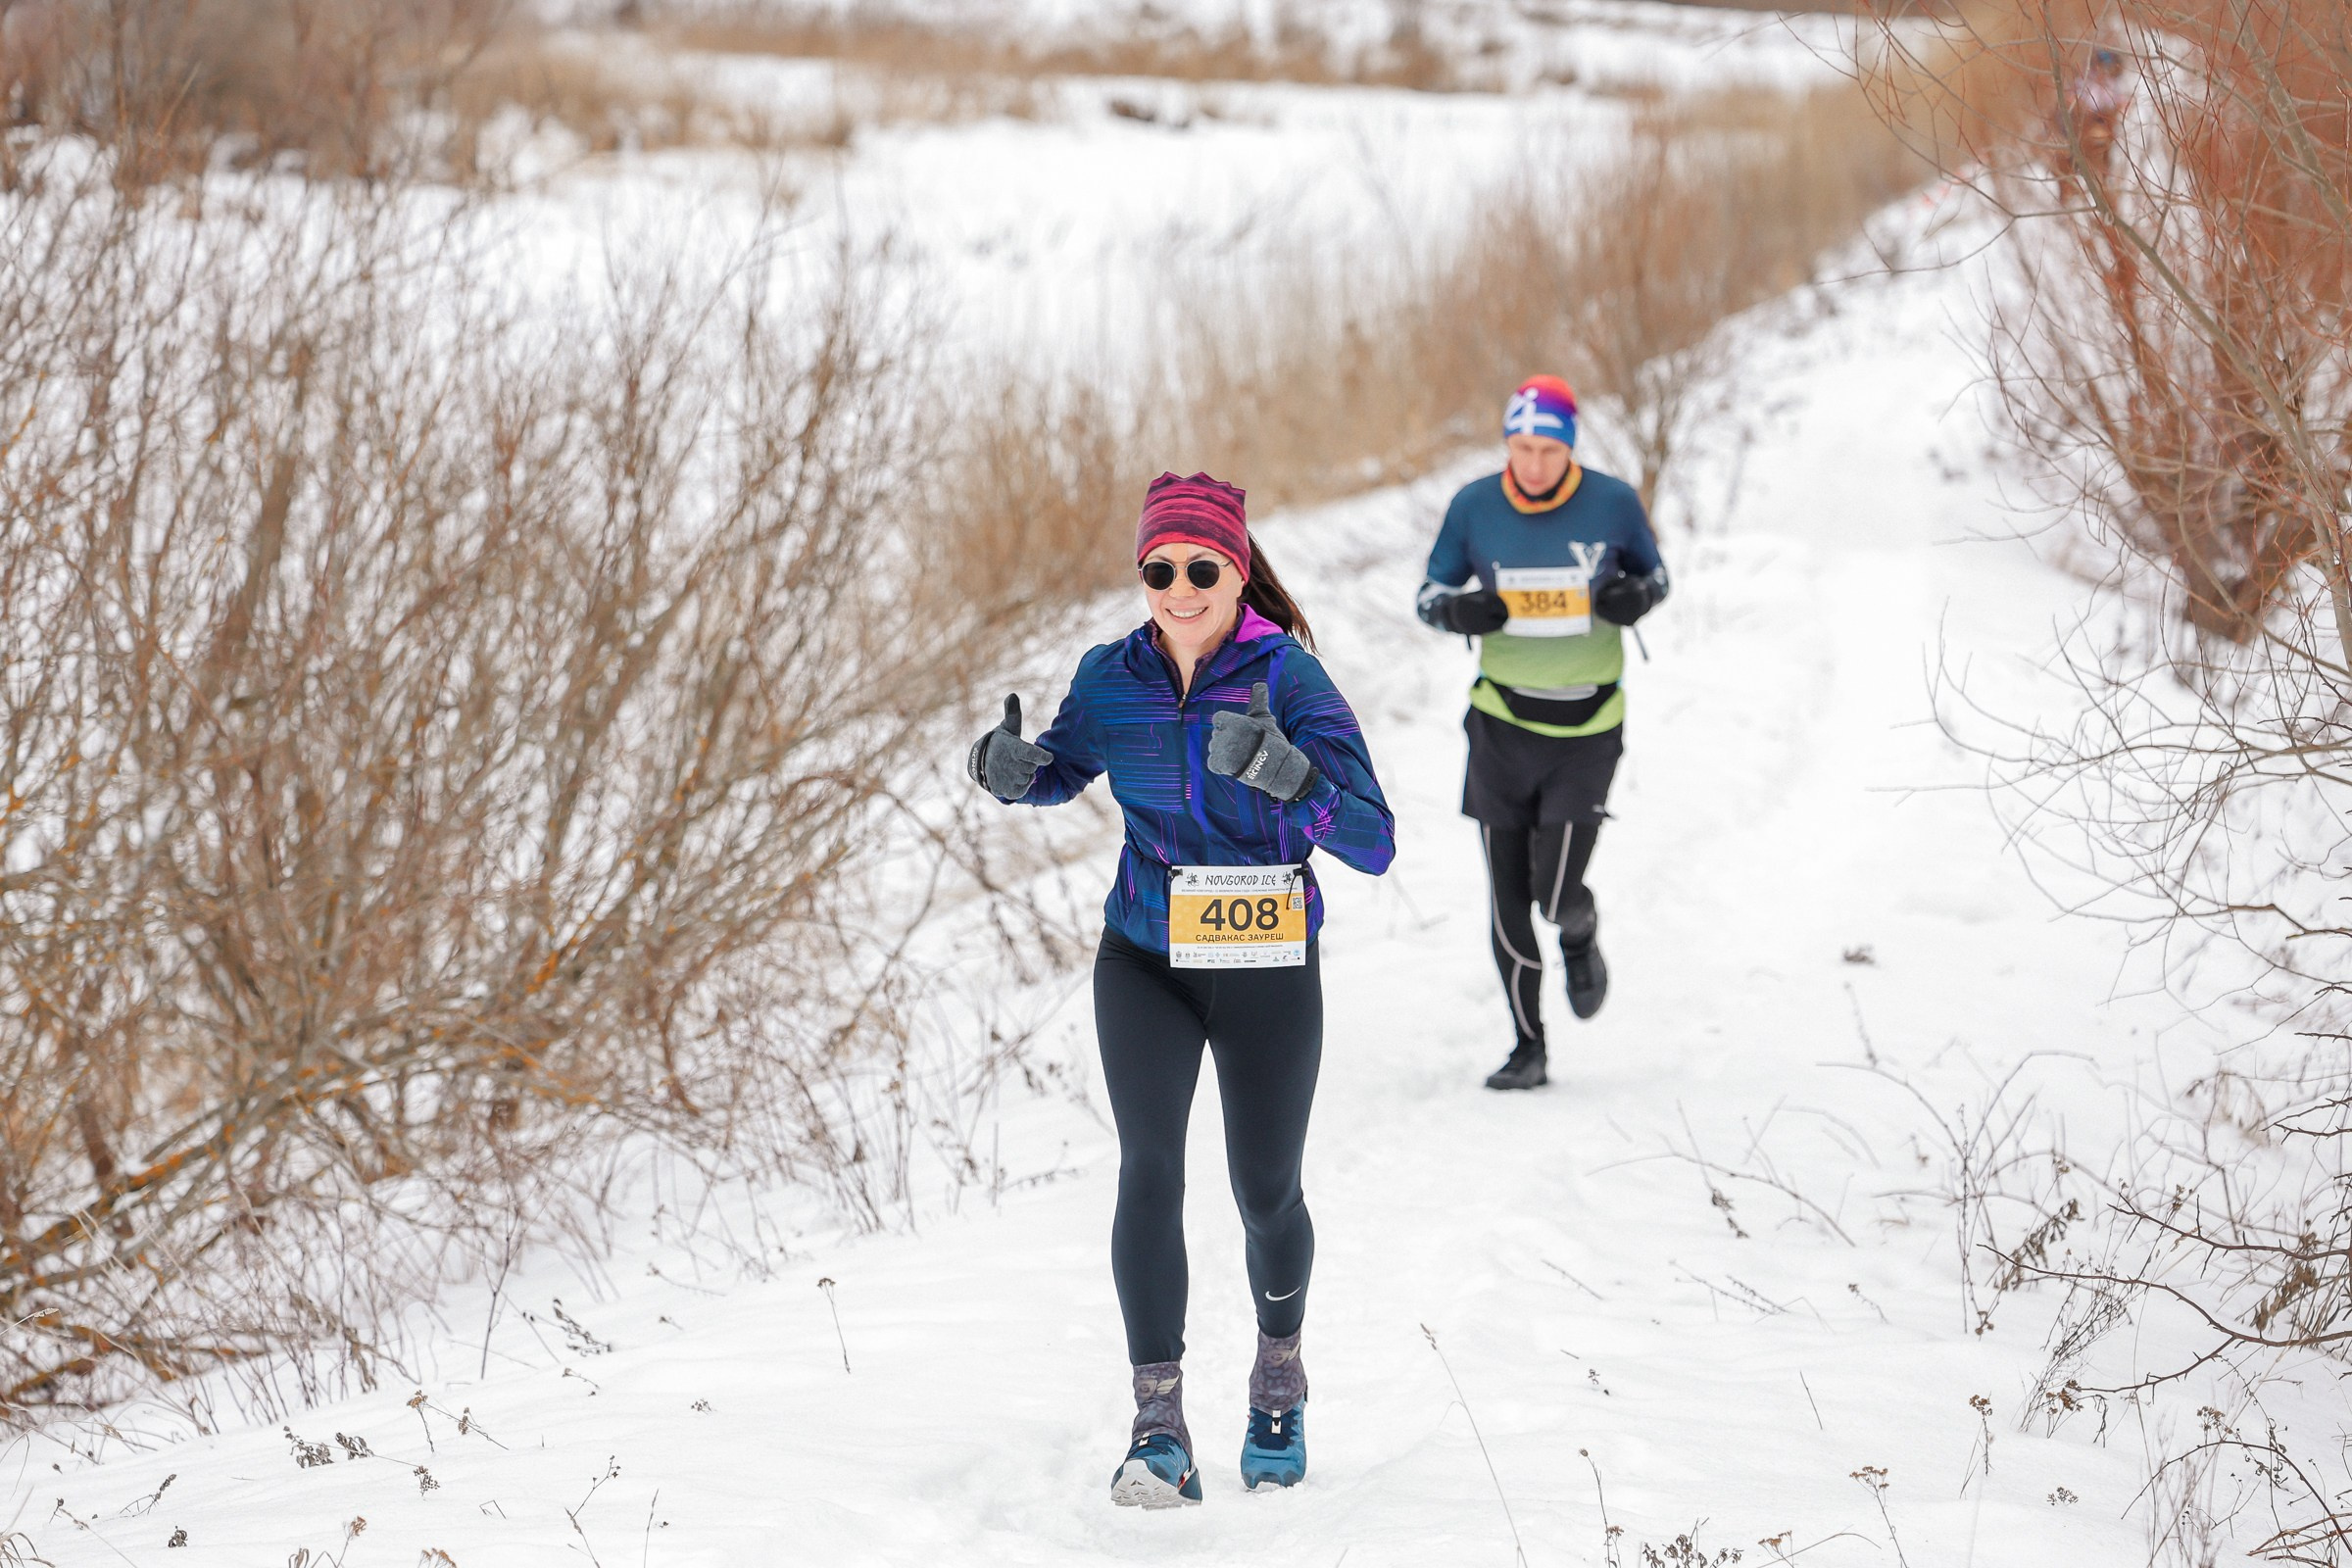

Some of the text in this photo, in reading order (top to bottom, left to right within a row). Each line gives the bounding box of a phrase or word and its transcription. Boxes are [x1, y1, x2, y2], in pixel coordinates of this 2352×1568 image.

[1520, 591, 1567, 612] 384
[1204, 874, 1276, 886] NOVGOROD ICE
[1200, 897, 1280, 931] 408
[1195, 934, 1246, 943] САДВАКАС
